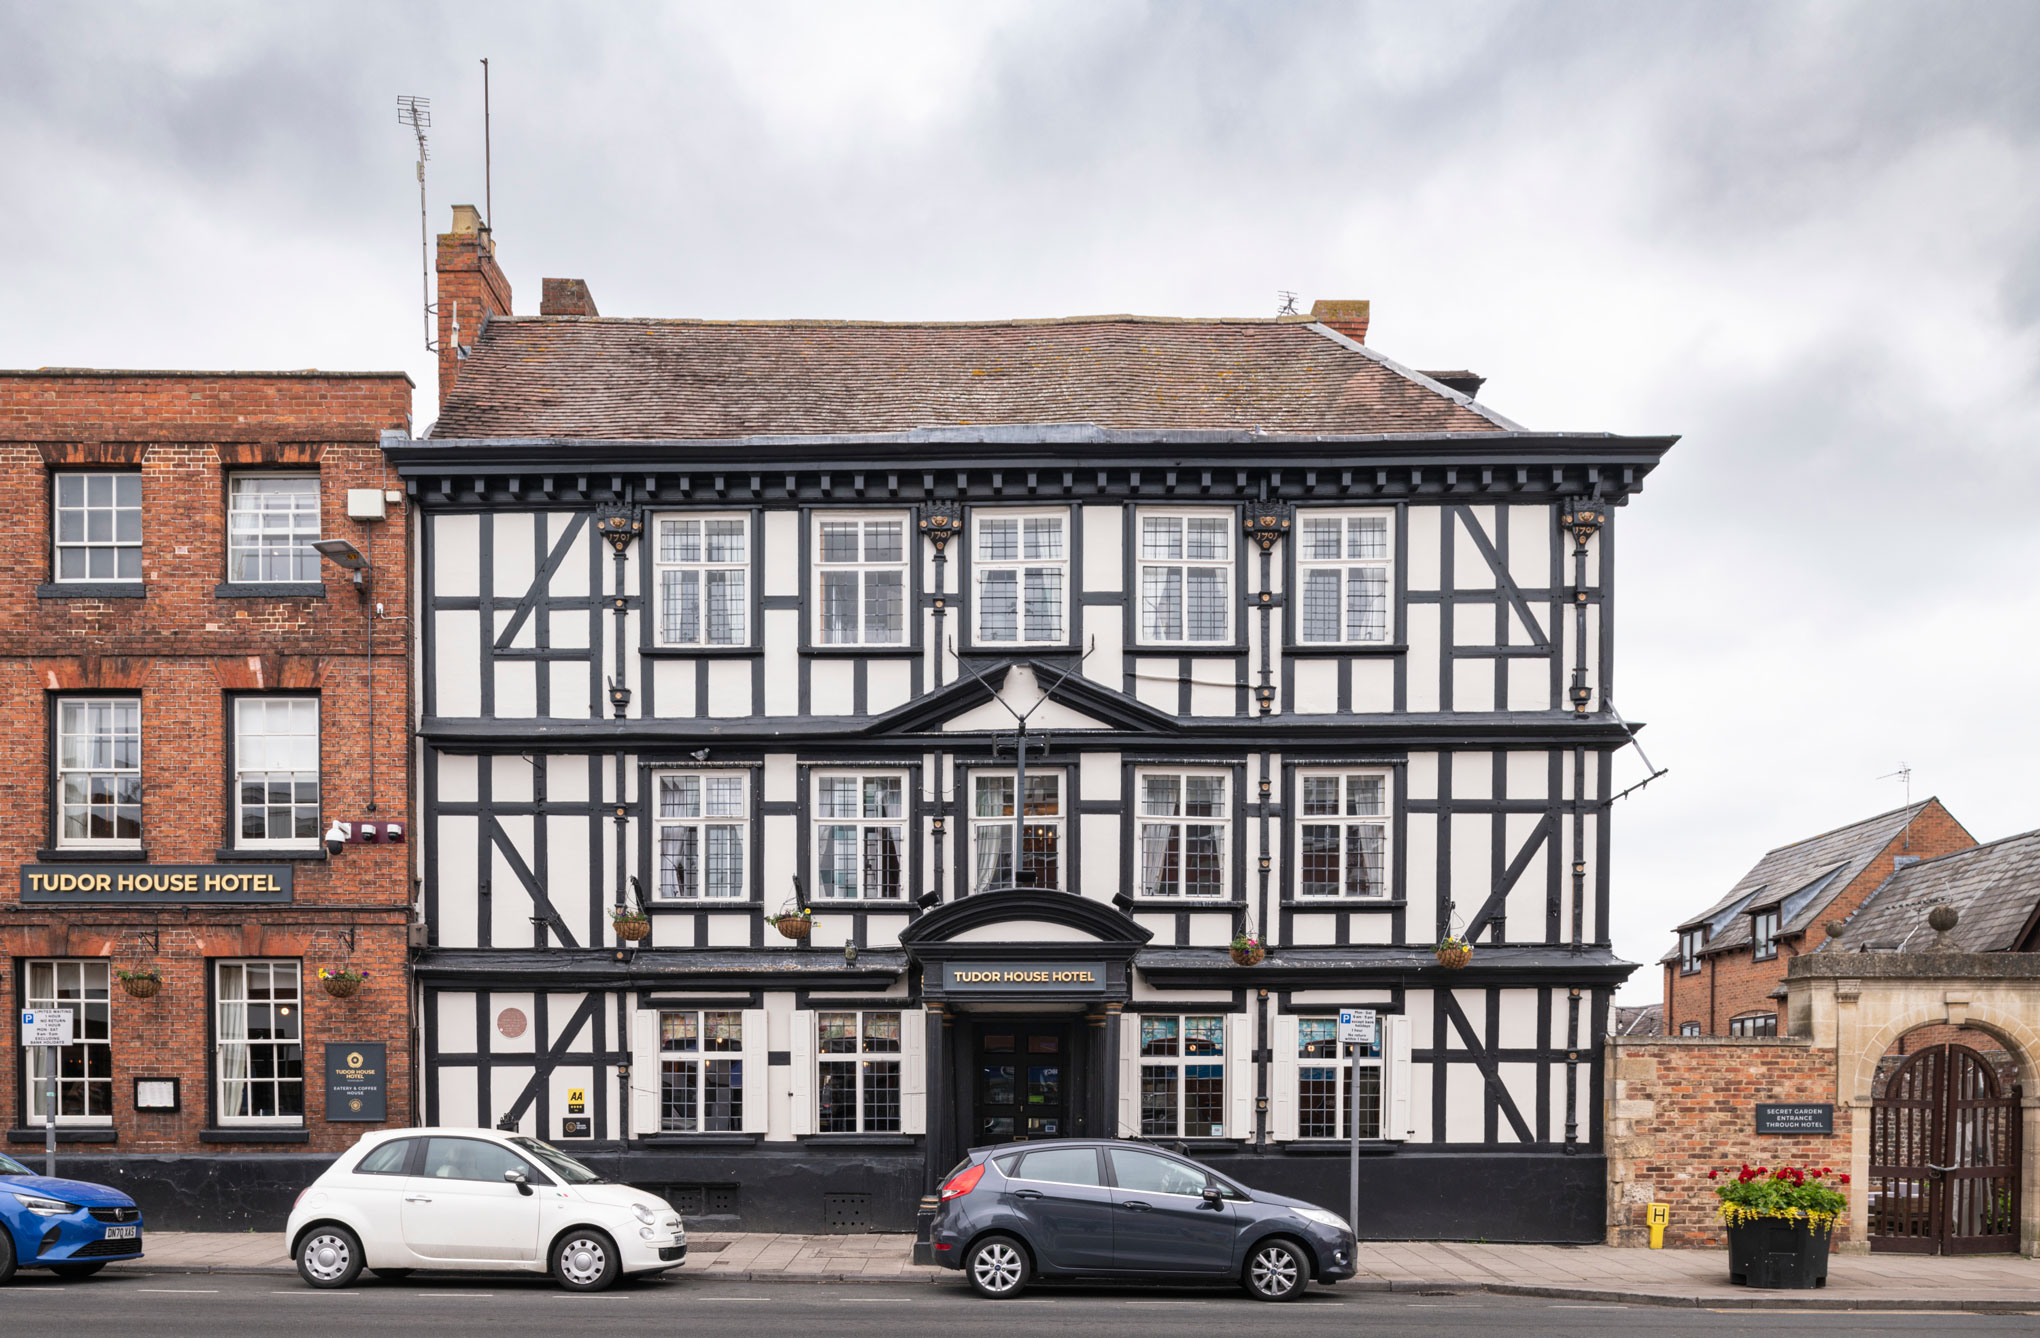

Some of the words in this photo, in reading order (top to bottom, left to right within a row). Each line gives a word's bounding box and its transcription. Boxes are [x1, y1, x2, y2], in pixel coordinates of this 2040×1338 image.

[28, 873, 112, 892] TUDOR
[117, 873, 198, 892] HOUSE
[204, 873, 281, 892] HOTEL
[954, 971, 1001, 982] TUDOR
[1004, 971, 1049, 982] HOUSE
[1052, 971, 1096, 982] HOTEL
[25, 1014, 32, 1023] P
[1343, 1014, 1350, 1023] P
[570, 1091, 583, 1101] AA
[1653, 1207, 1666, 1223] H
